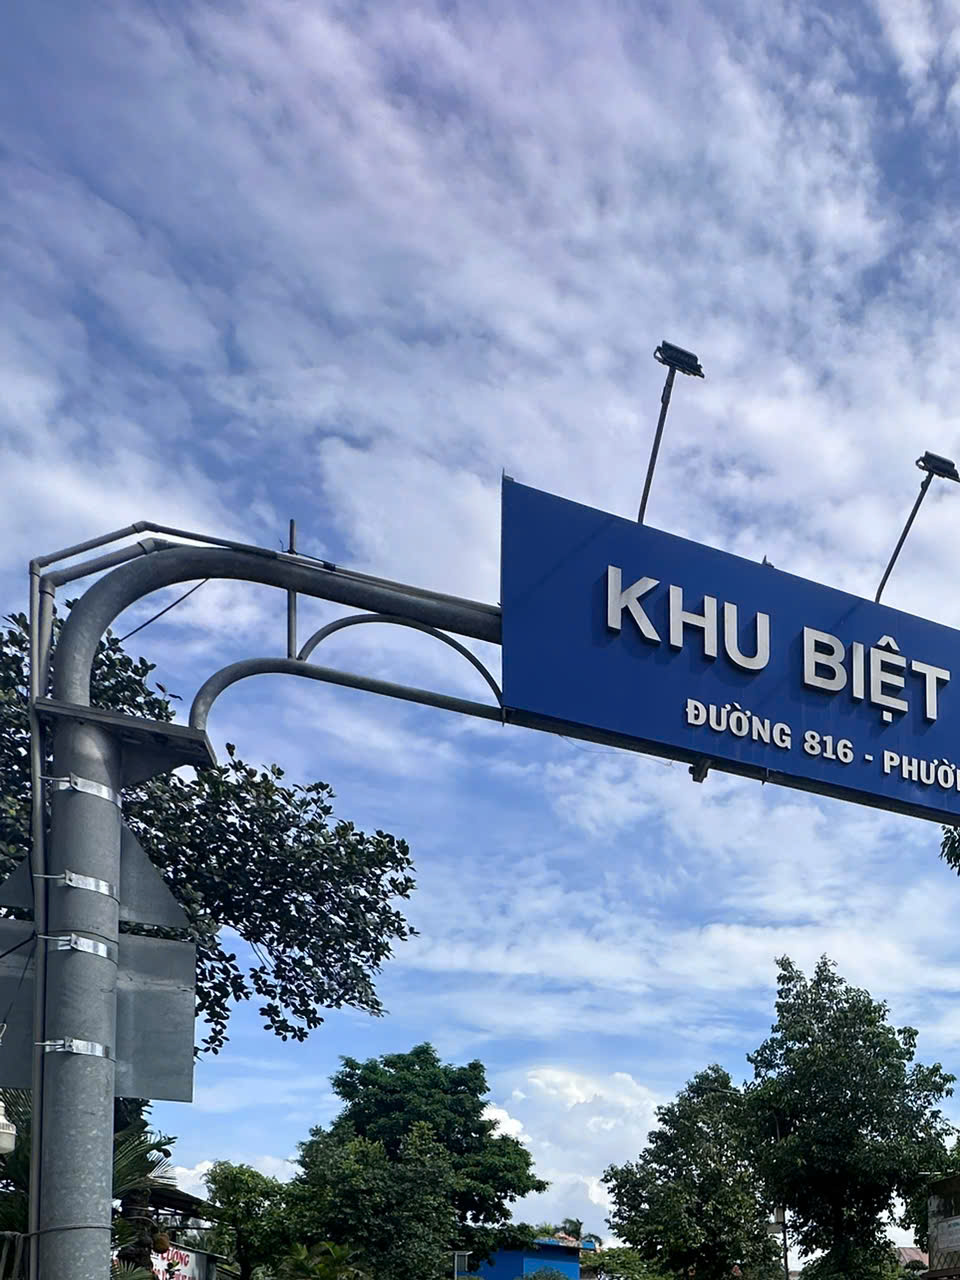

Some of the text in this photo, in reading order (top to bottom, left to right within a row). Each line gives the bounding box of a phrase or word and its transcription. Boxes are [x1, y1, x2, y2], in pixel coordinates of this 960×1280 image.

[607, 565, 771, 671] KHU
[803, 626, 951, 723] BIỆT
[686, 698, 792, 750] ĐƯỜNG
[803, 730, 854, 764] 816
